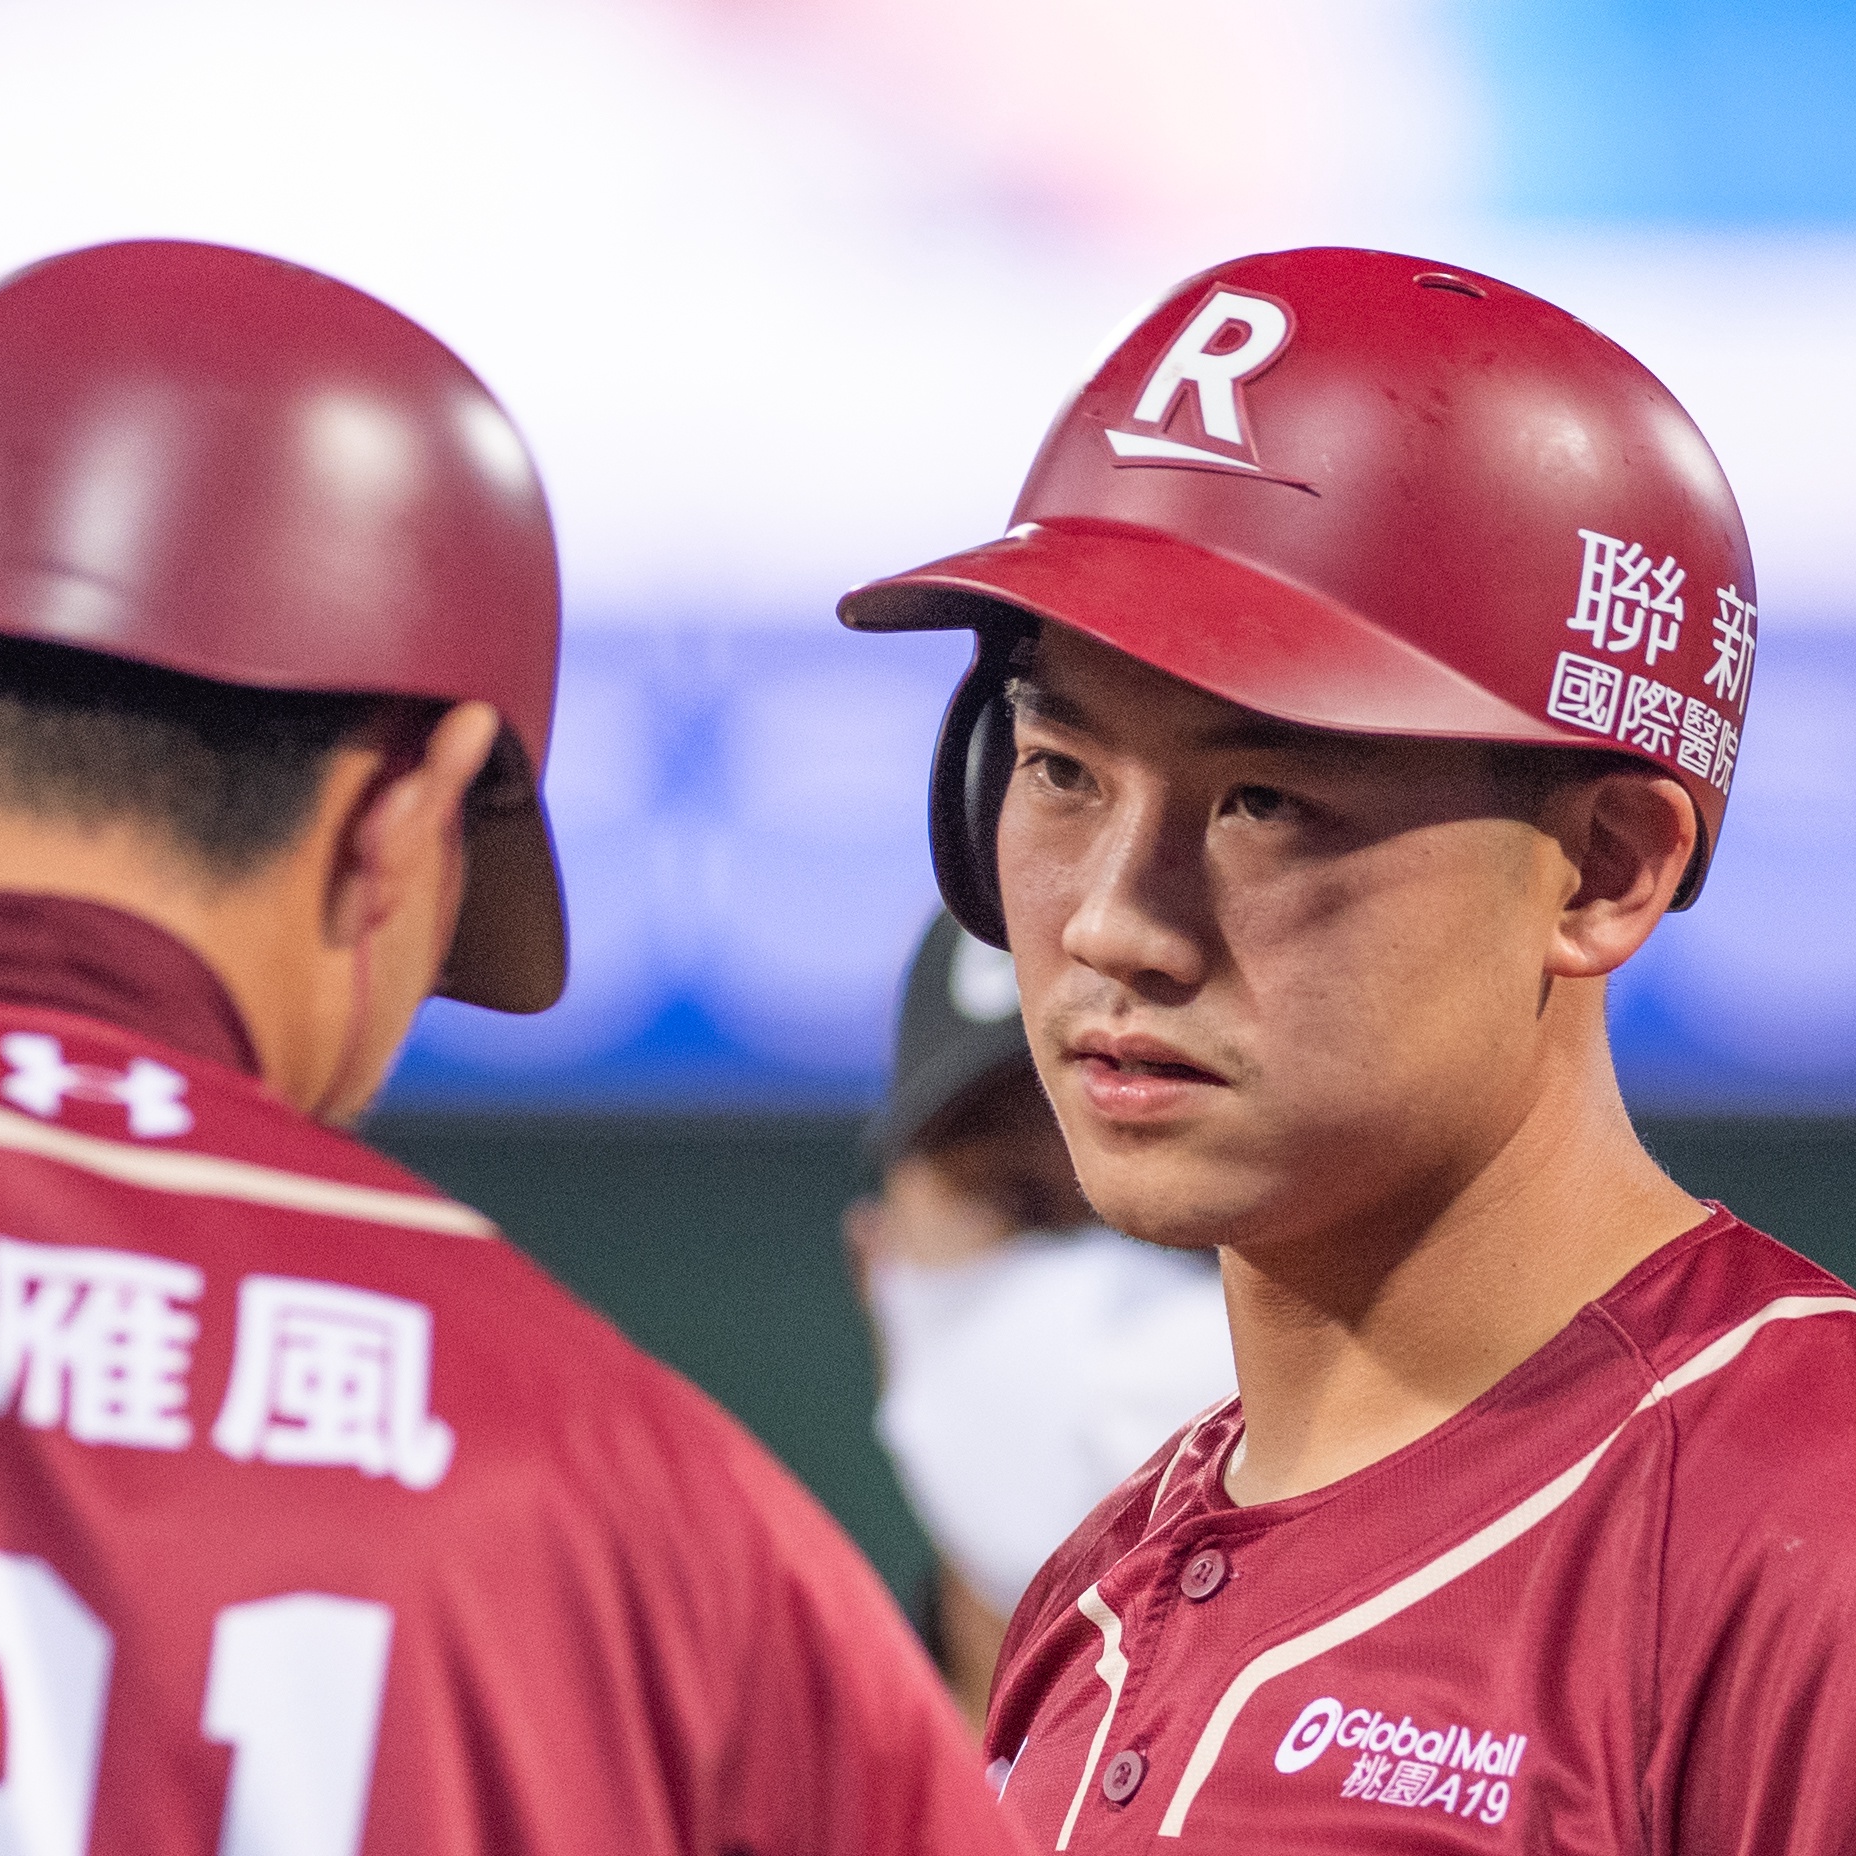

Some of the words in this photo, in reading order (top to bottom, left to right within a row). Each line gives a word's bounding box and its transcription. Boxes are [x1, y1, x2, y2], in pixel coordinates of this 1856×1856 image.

[1132, 290, 1288, 446] R
[1546, 650, 1740, 797] 國際醫院
[1339, 1751, 1512, 1825] 桃園A19
